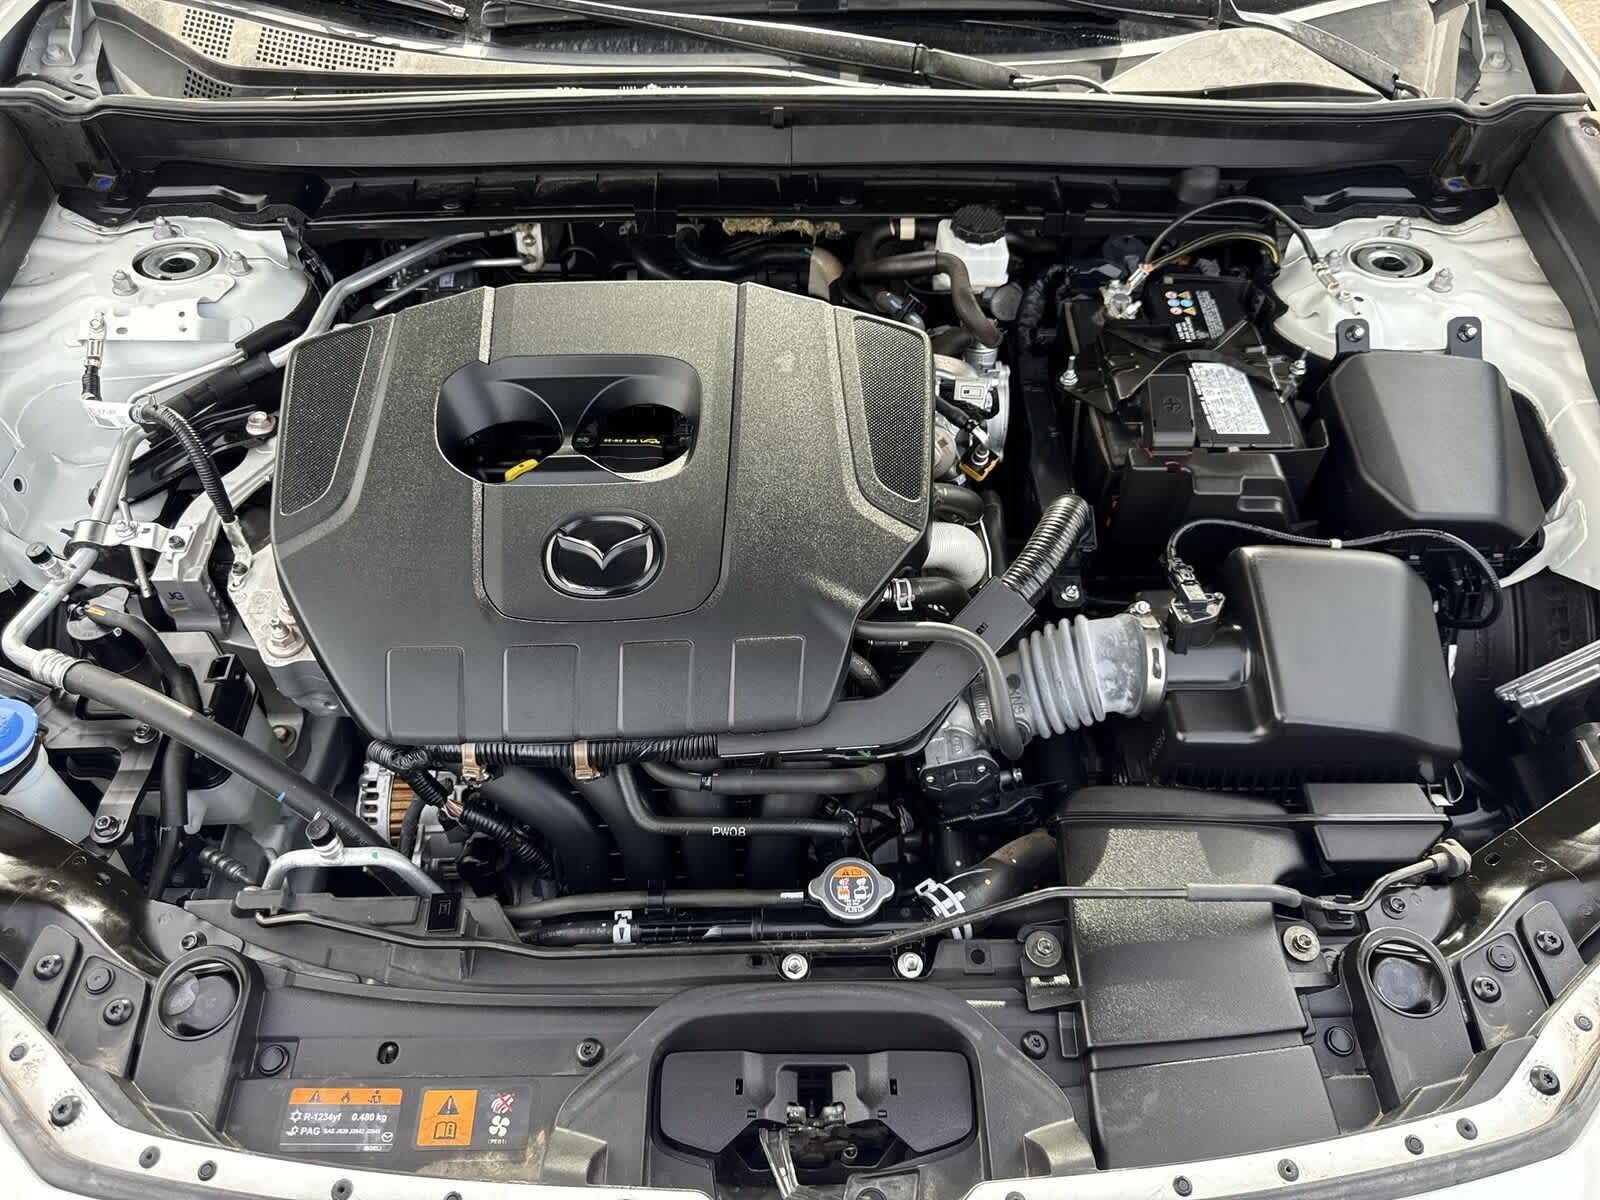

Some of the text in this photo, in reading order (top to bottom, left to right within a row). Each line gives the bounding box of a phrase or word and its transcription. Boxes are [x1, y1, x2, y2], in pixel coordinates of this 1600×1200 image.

[712, 826, 746, 837] PW08
[303, 1112, 388, 1123] R-1234yf 0.480 kg
[300, 1126, 321, 1136] PAG
